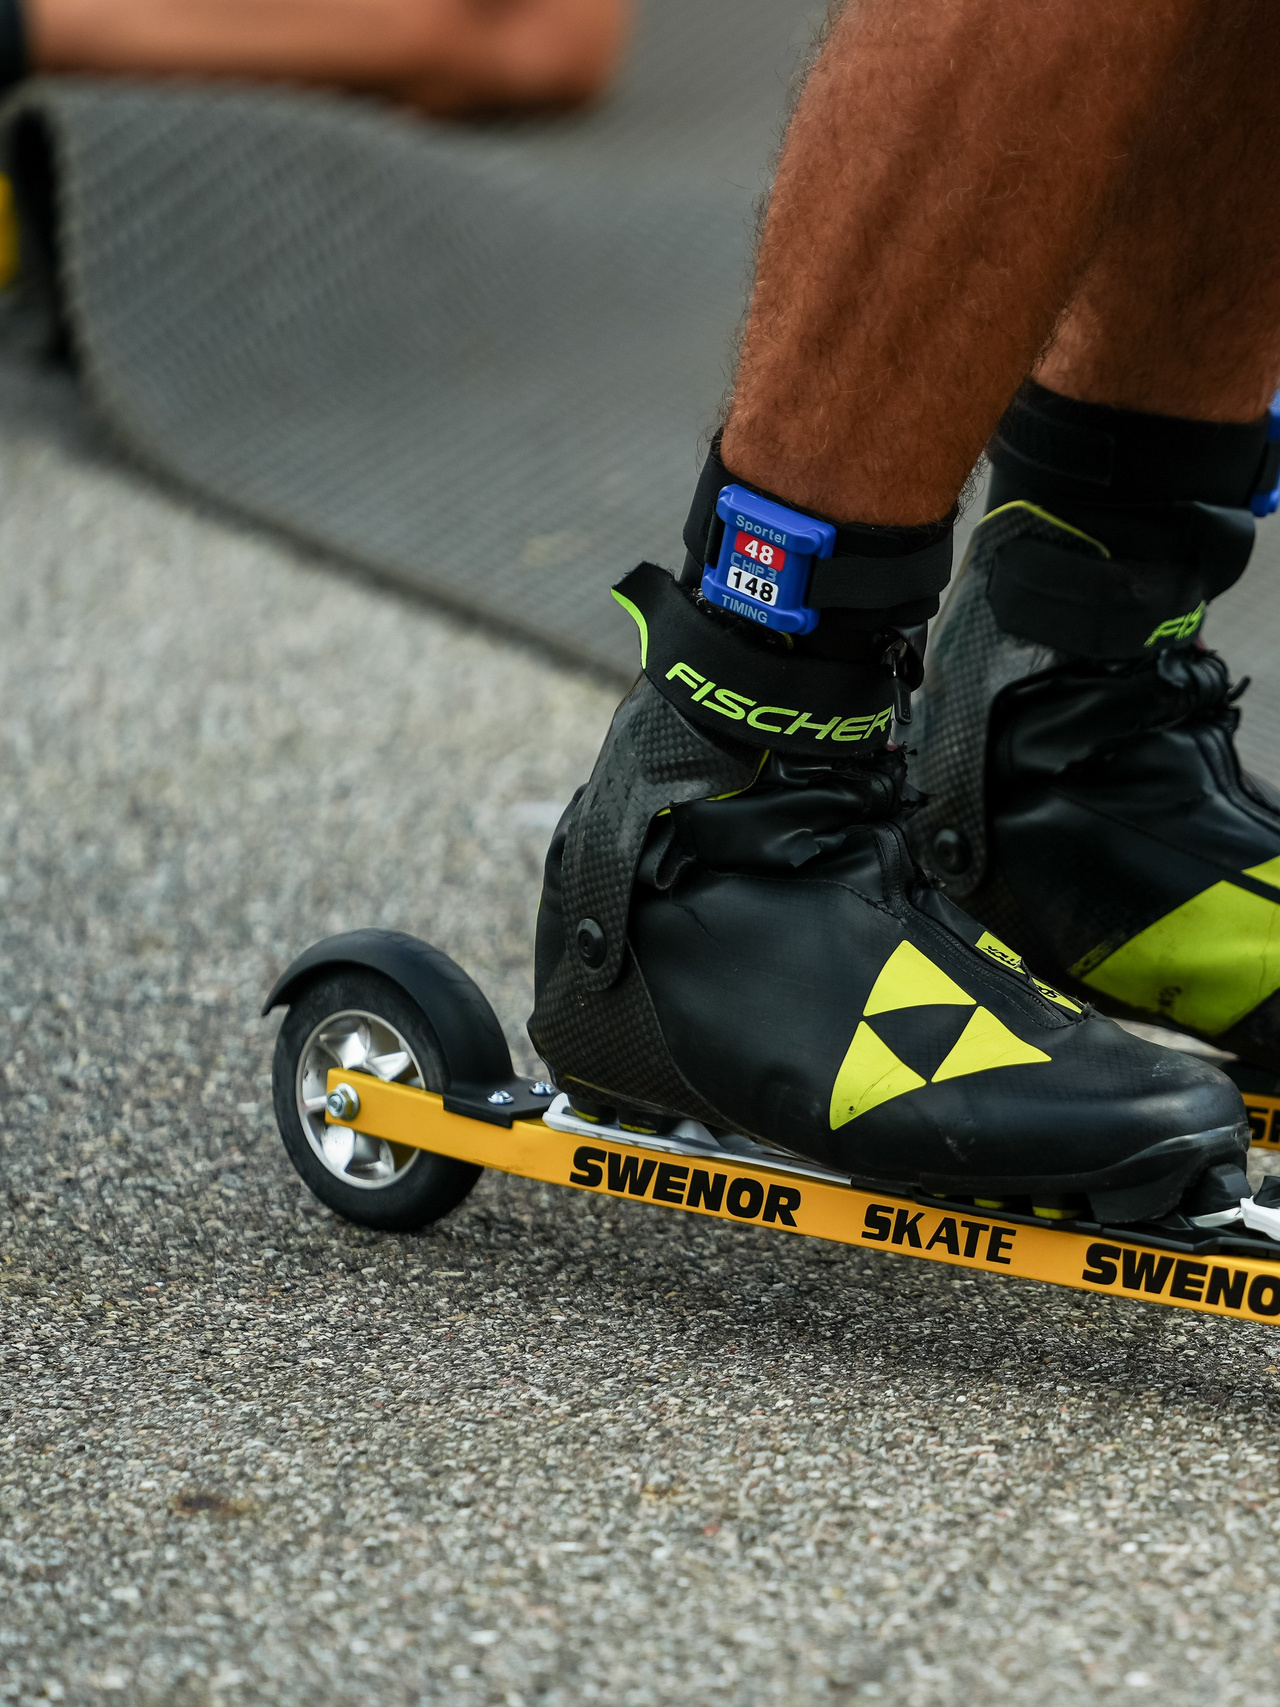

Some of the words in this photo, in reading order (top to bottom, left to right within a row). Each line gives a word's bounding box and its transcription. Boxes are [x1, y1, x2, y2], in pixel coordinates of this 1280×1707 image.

[735, 514, 787, 546] Sportel
[744, 539, 774, 565] 48
[733, 570, 773, 602] 148
[722, 593, 768, 624] TIMING
[665, 661, 893, 742] FISCHER
[569, 1144, 801, 1228] SWENOR
[861, 1202, 1017, 1266] SKATE
